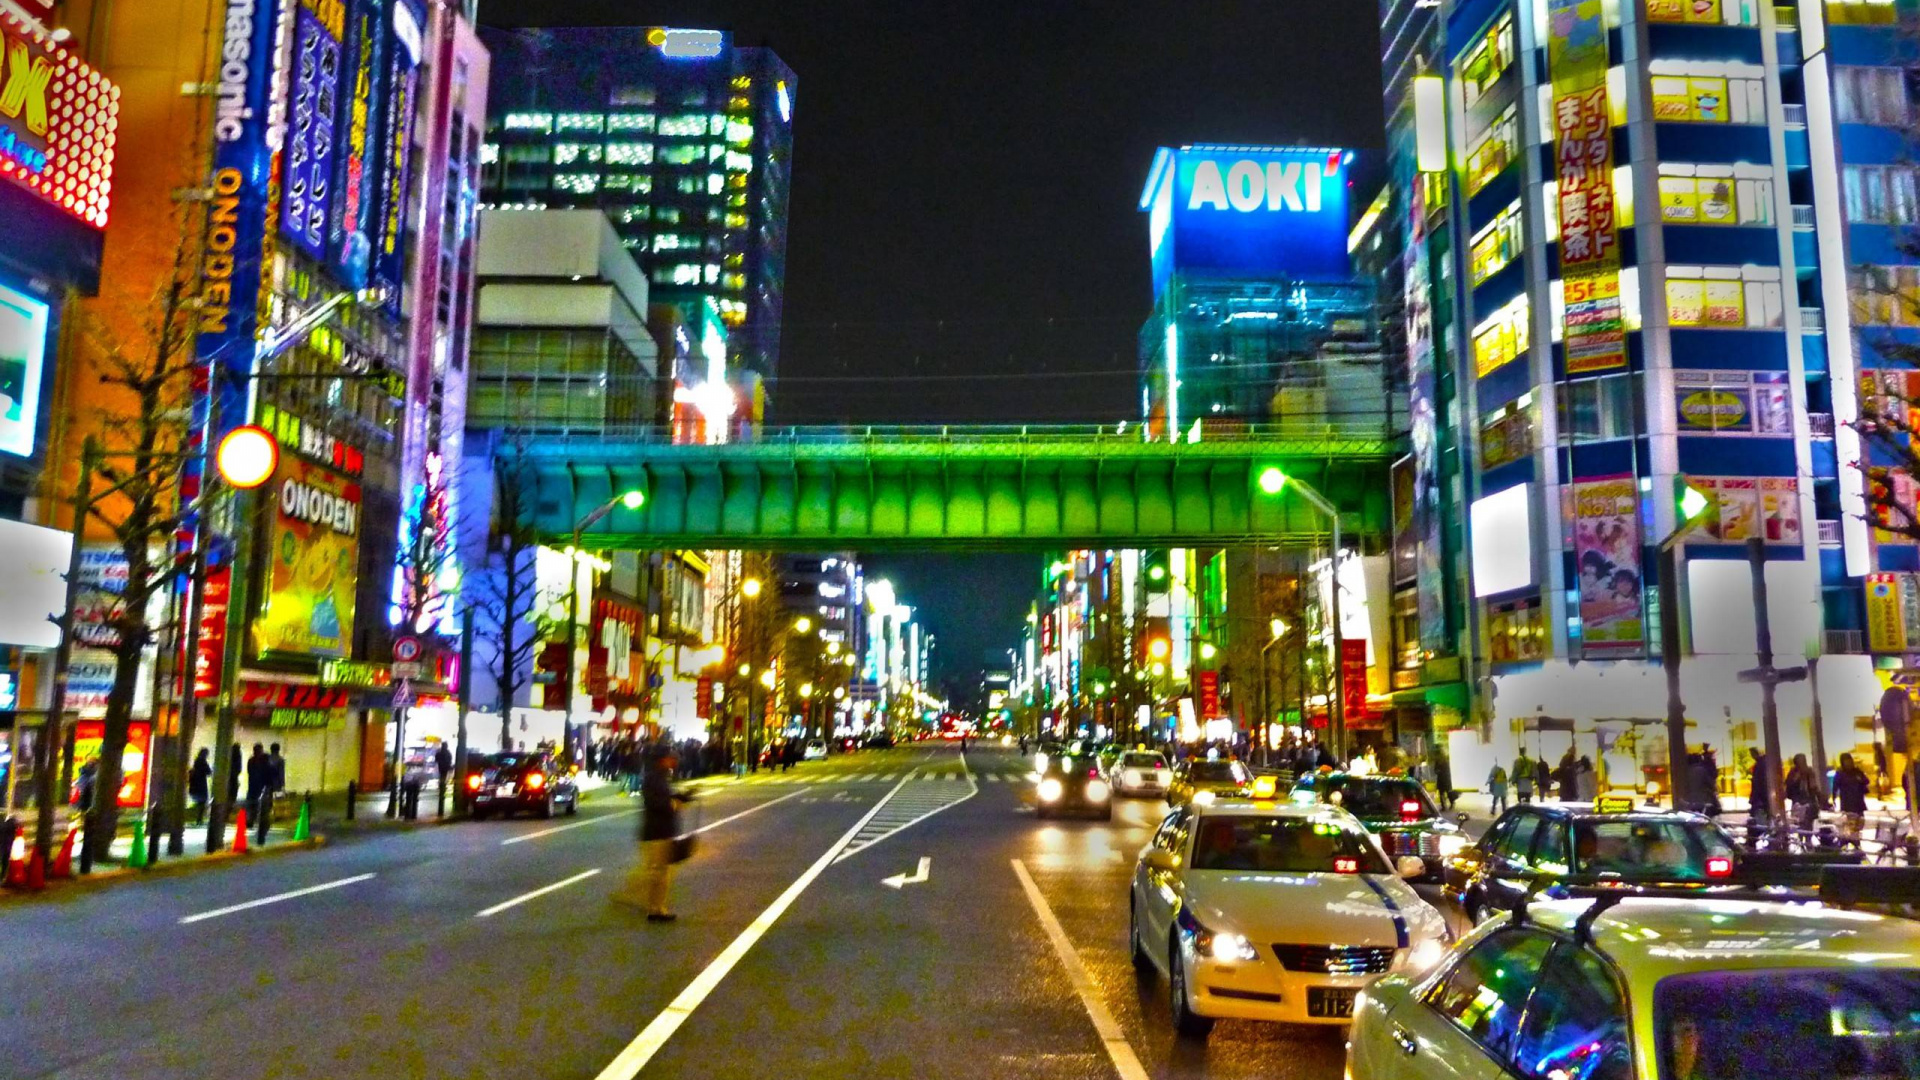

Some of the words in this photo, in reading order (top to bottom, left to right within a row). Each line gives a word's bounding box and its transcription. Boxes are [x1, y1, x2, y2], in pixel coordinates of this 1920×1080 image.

[1187, 160, 1322, 213] AOKI
[1557, 98, 1590, 260] まんが喫茶
[1586, 90, 1613, 256] インターネット
[200, 166, 243, 334] ONODEN
[282, 477, 356, 535] ONODEN
[1323, 998, 1356, 1016] 11-2
